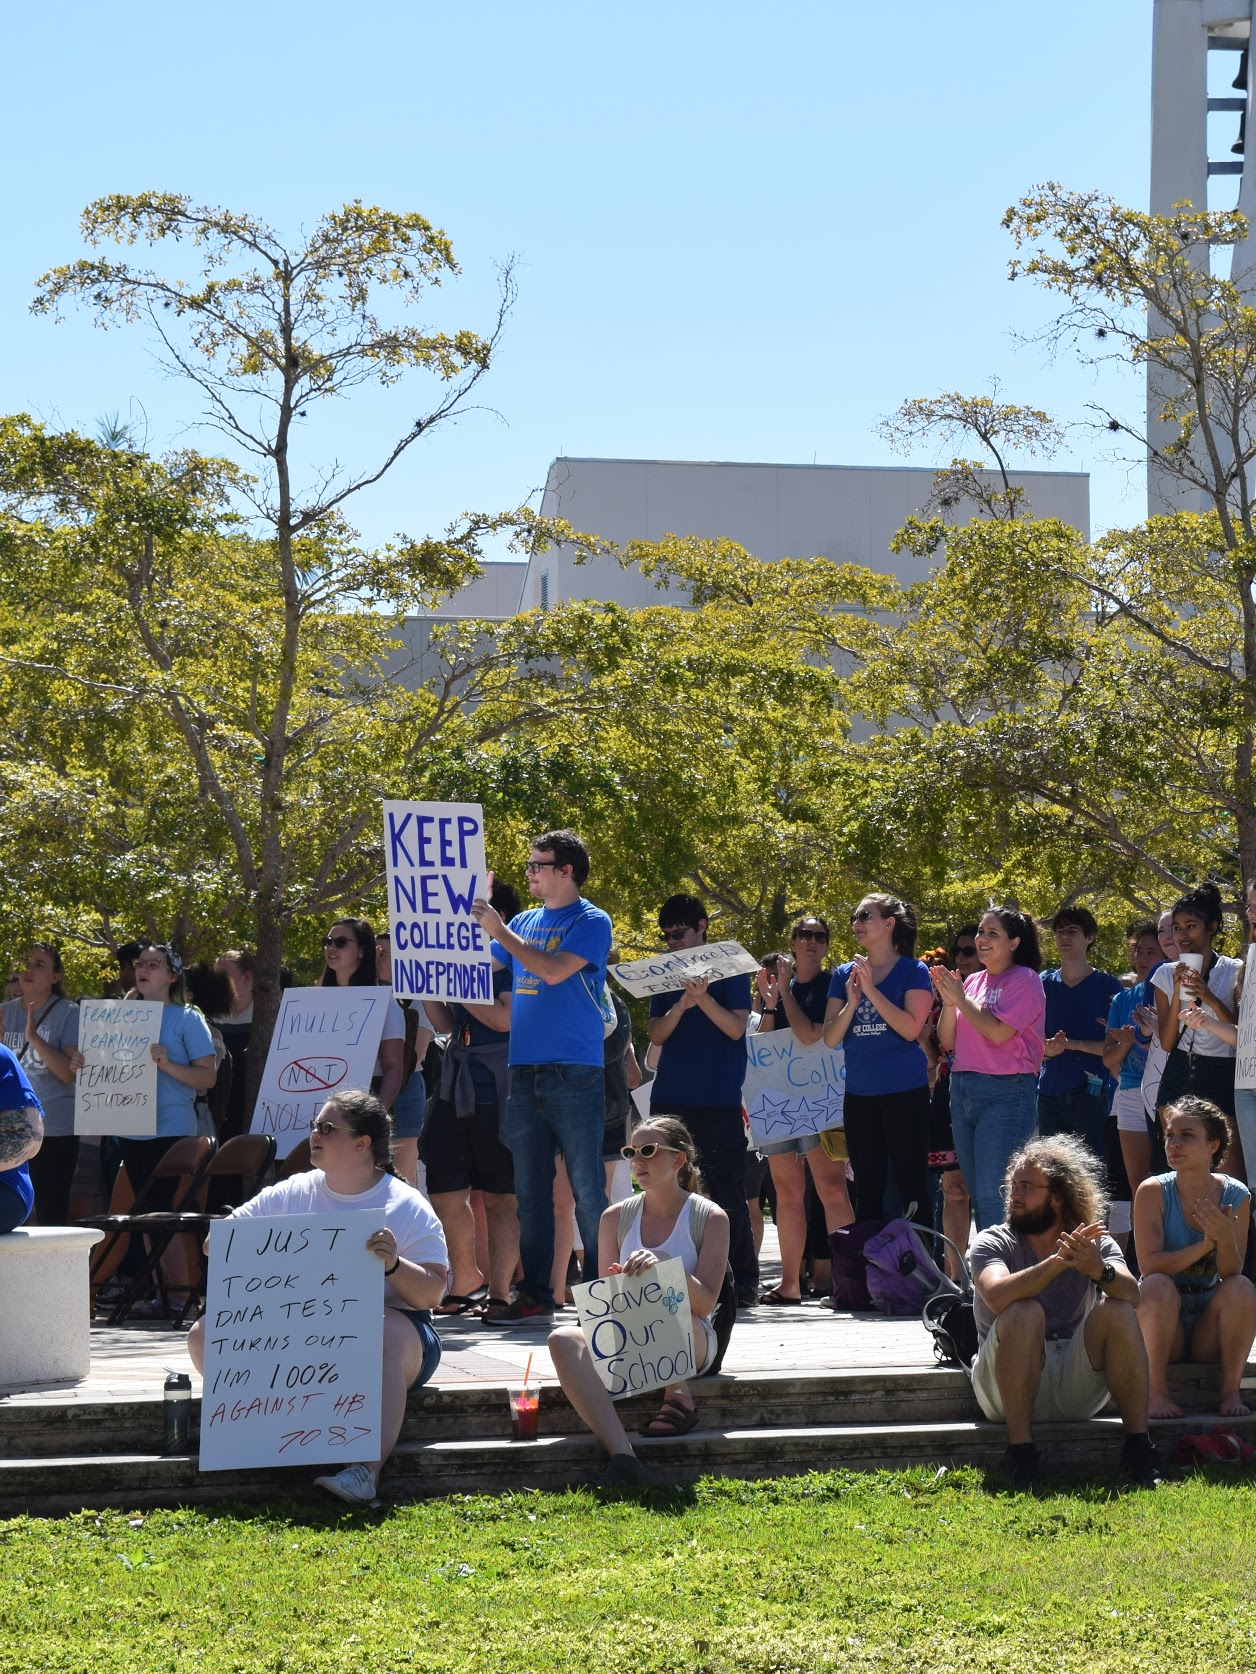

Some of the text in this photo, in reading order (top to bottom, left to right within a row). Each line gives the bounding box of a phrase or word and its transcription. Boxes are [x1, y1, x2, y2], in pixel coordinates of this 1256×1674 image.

[388, 812, 479, 869] KEEP
[394, 873, 477, 916] NEW
[395, 921, 484, 952] COLLEGE
[394, 958, 491, 1000] INDEPENDENT
[79, 1064, 147, 1088] FEARLESS
[288, 1064, 337, 1086] NOT
[225, 1228, 346, 1263] I JUST
[222, 1273, 340, 1298] TOOK A
[585, 1280, 663, 1317] Save
[215, 1299, 358, 1328] DNA TEST
[212, 1335, 358, 1355] TURNS OUT
[591, 1319, 664, 1360] Our
[270, 1363, 340, 1389] 100%
[607, 1332, 693, 1396] School
[209, 1392, 366, 1427] AGAINST HB
[278, 1426, 372, 1453] 7087
